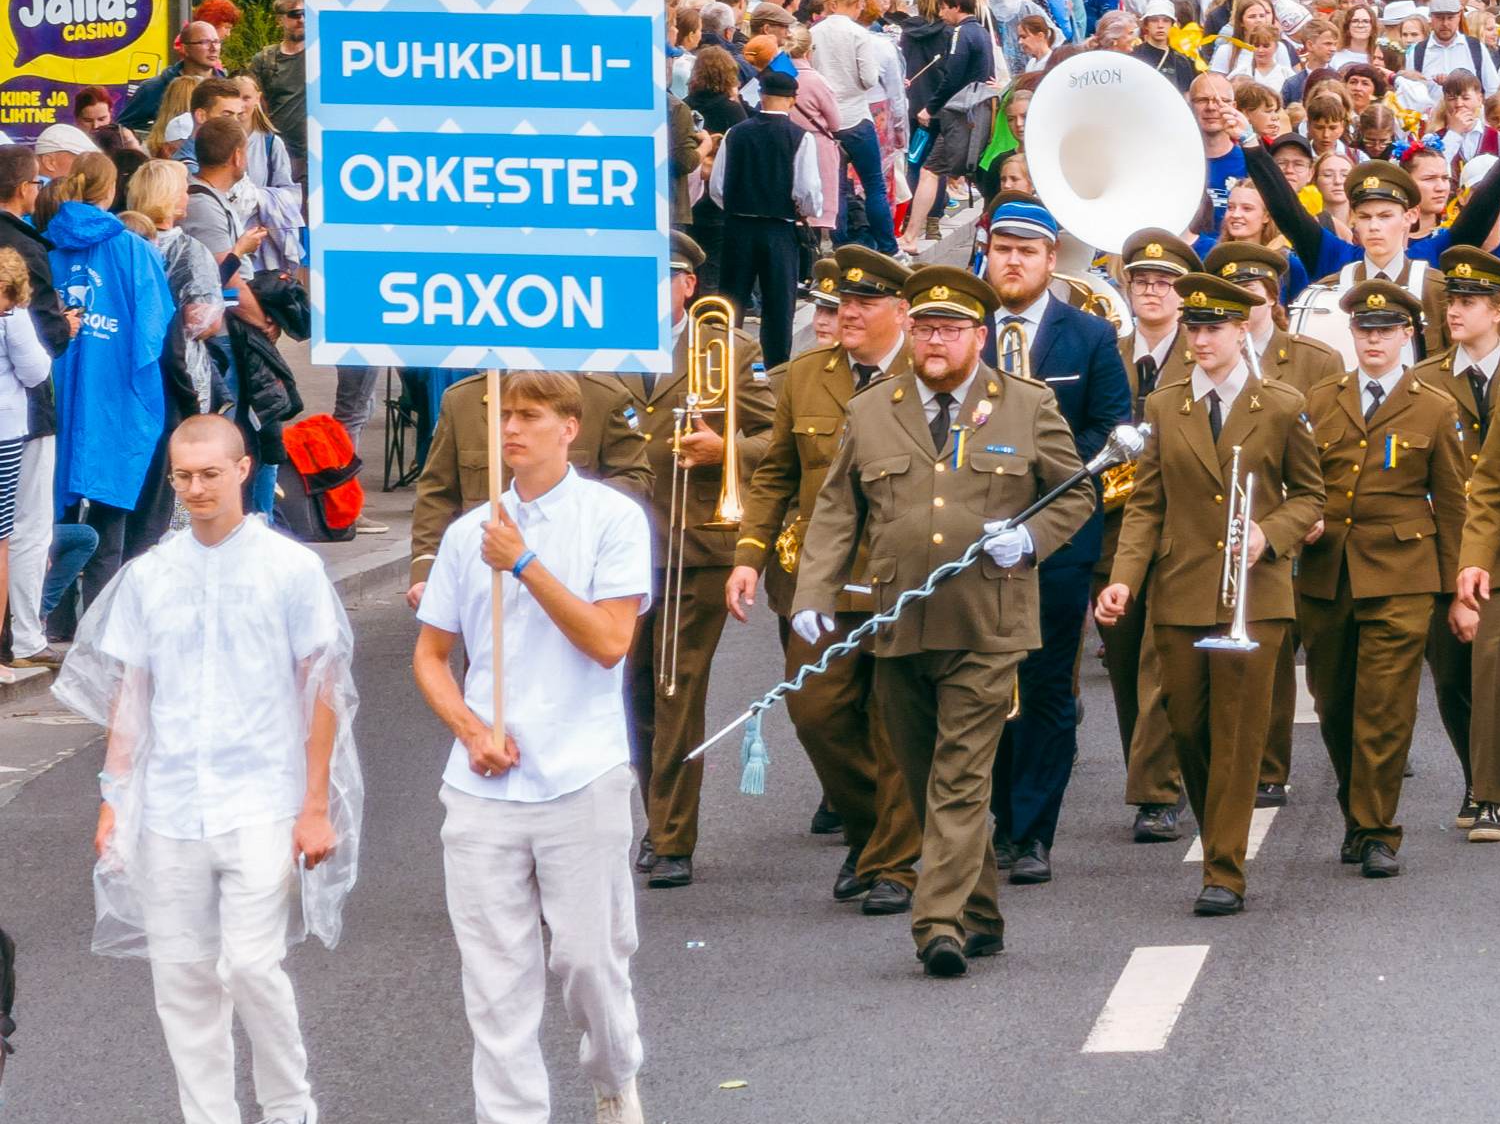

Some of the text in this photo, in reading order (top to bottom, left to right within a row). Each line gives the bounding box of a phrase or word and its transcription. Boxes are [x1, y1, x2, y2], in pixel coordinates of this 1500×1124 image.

[63, 20, 126, 42] CASINO
[341, 40, 631, 82] PUHKPILLI-
[1068, 68, 1123, 89] SAXON
[0, 90, 69, 107] KIIRE JA
[0, 107, 57, 124] LIHTNE
[339, 154, 639, 206] ORKESTER
[379, 272, 604, 328] SAXON
